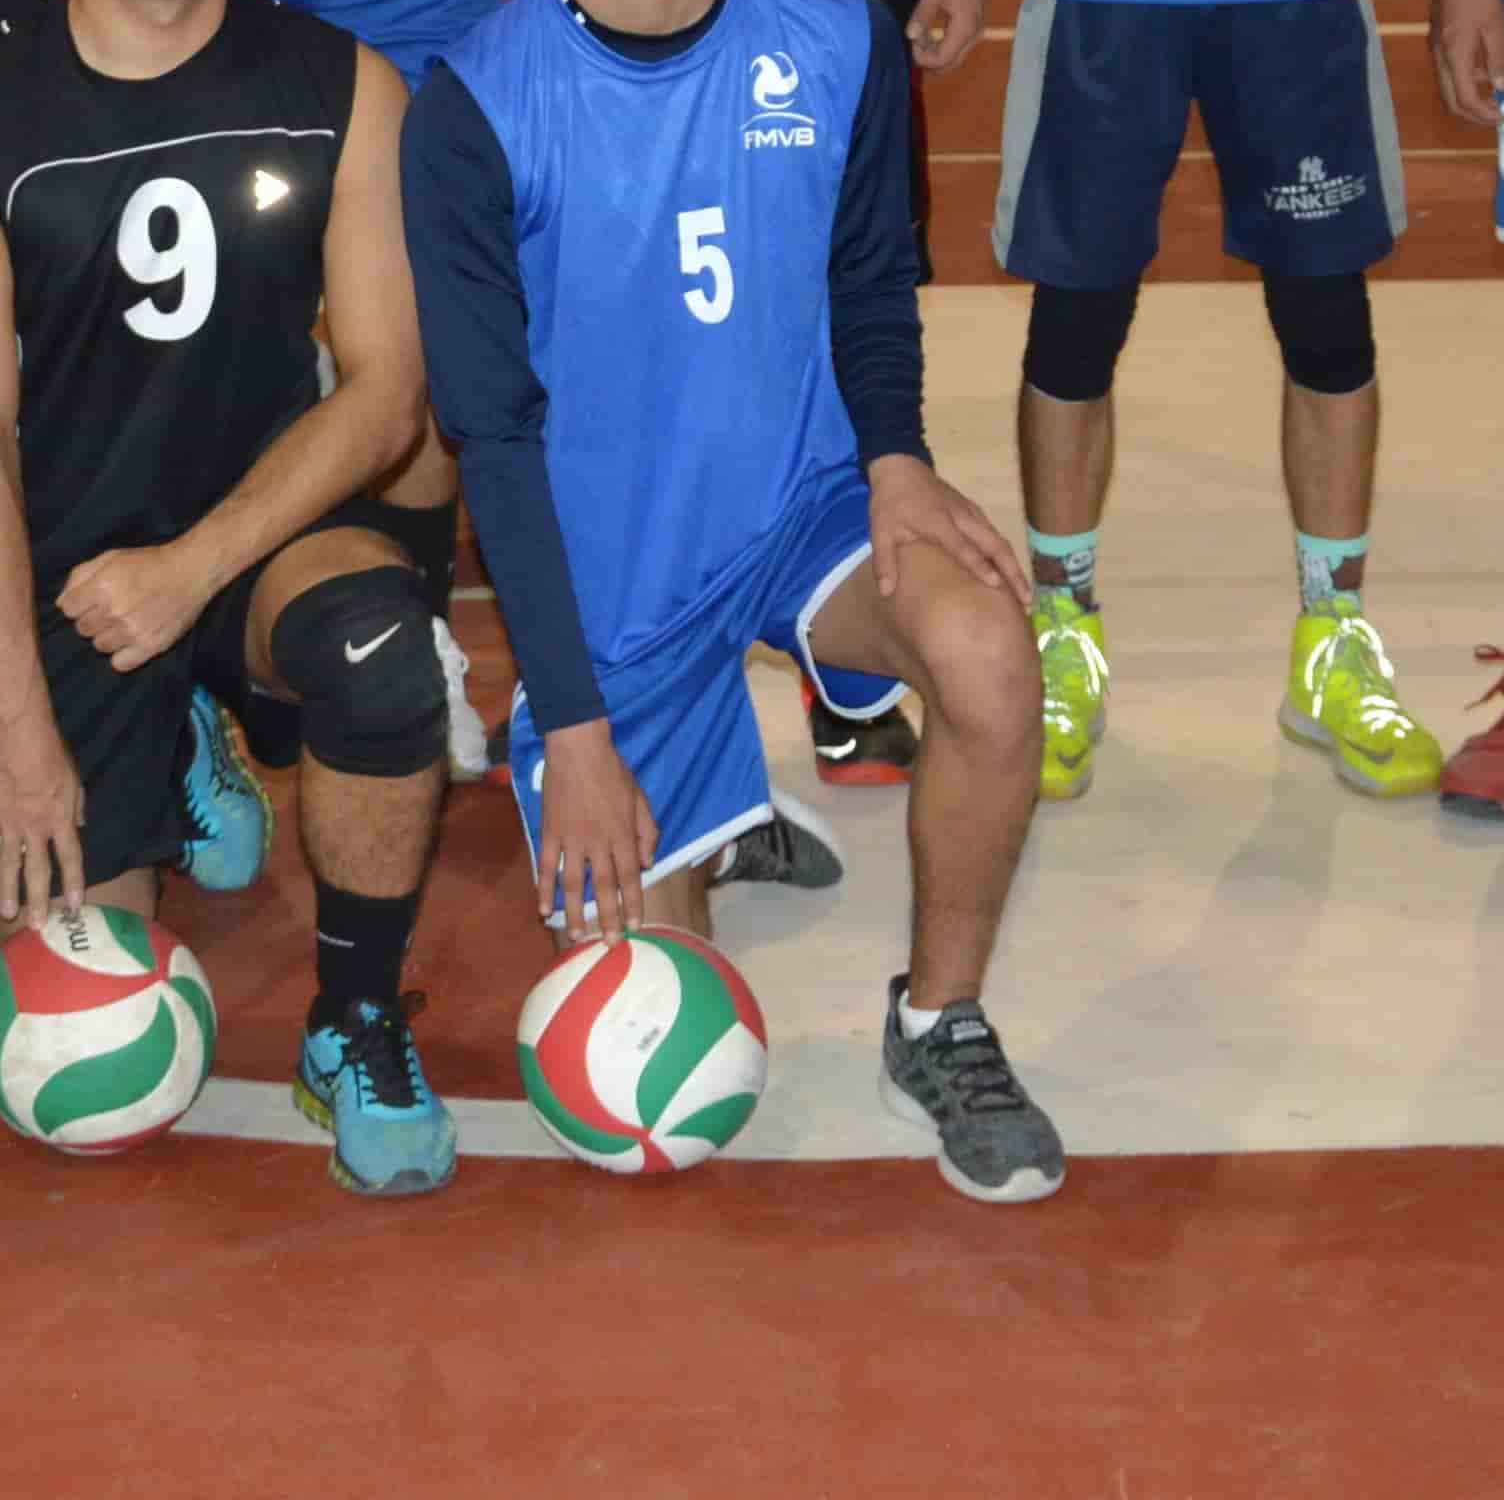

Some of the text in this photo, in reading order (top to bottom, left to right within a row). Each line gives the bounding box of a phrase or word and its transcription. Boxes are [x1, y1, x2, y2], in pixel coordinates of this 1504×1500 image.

[744, 127, 815, 149] FMVB
[116, 177, 217, 341] 9
[677, 206, 734, 324] 5
